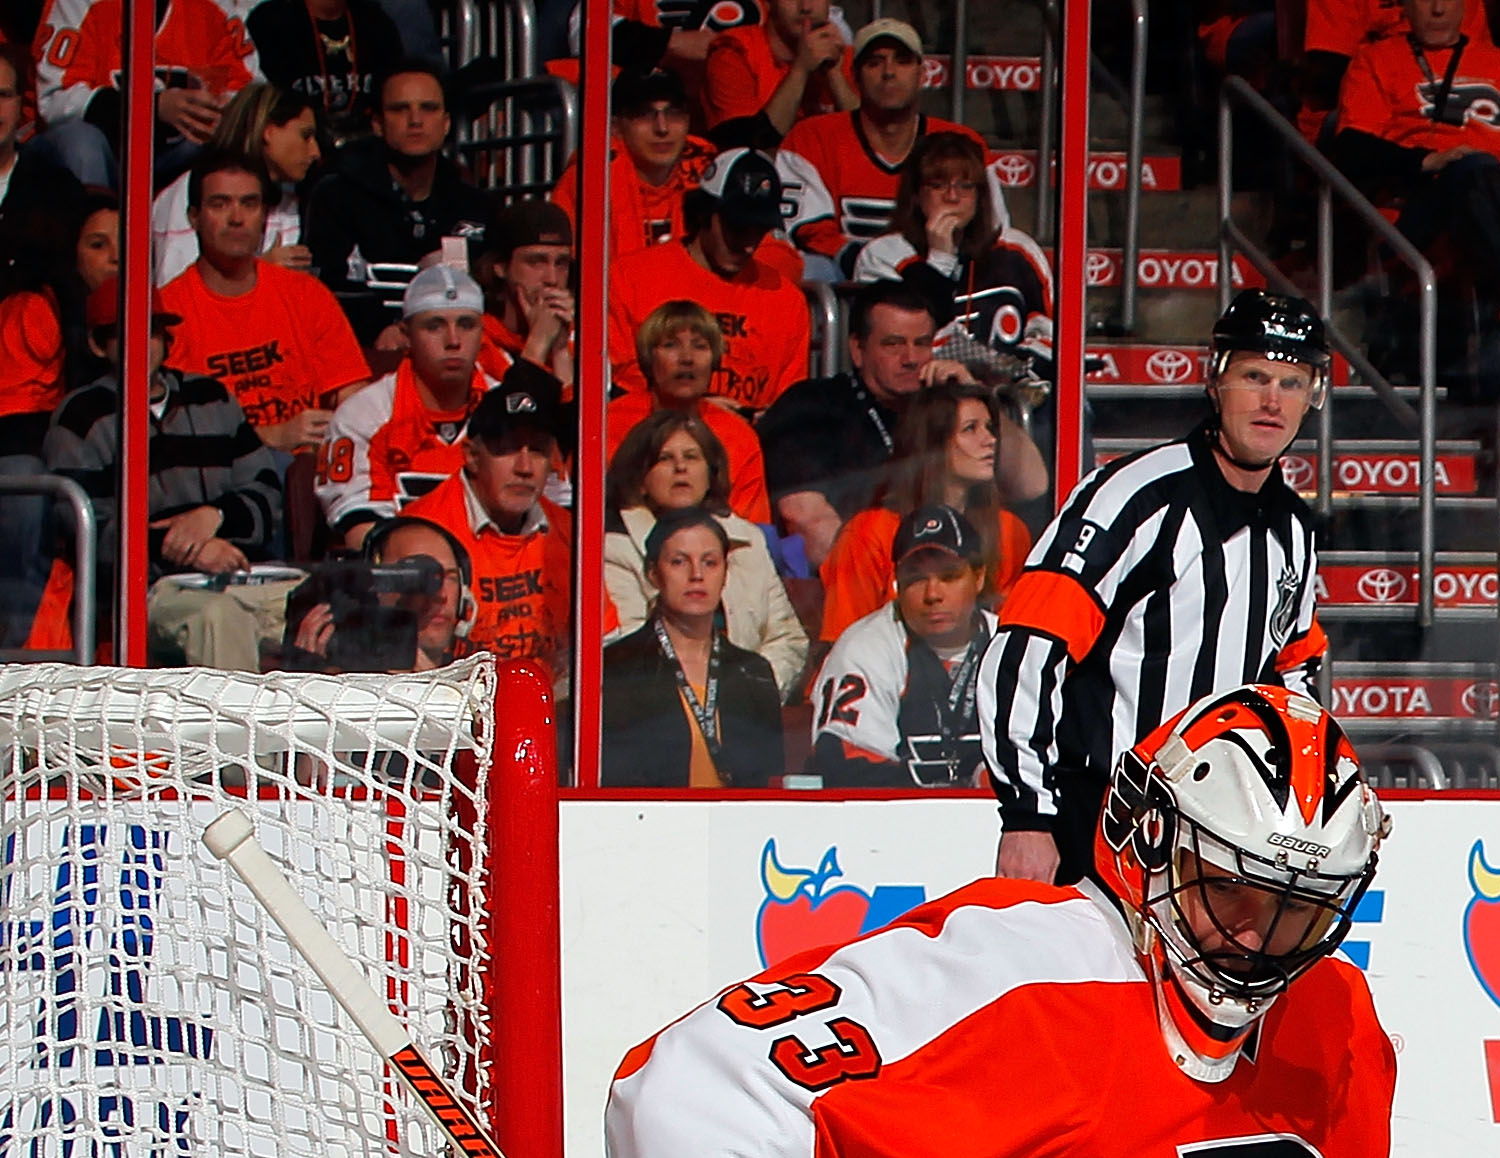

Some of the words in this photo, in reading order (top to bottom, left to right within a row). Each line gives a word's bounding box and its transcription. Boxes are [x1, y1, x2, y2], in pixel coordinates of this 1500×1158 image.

[1121, 259, 1244, 285] OYOTA
[206, 338, 284, 379] SEEK
[1331, 460, 1451, 487] OYOTA
[1073, 523, 1097, 553] 9
[478, 569, 545, 603] SEEK
[817, 672, 869, 729] 12
[1331, 686, 1433, 713] YOTA
[1267, 832, 1332, 859] BAUER
[716, 972, 884, 1092] 33
